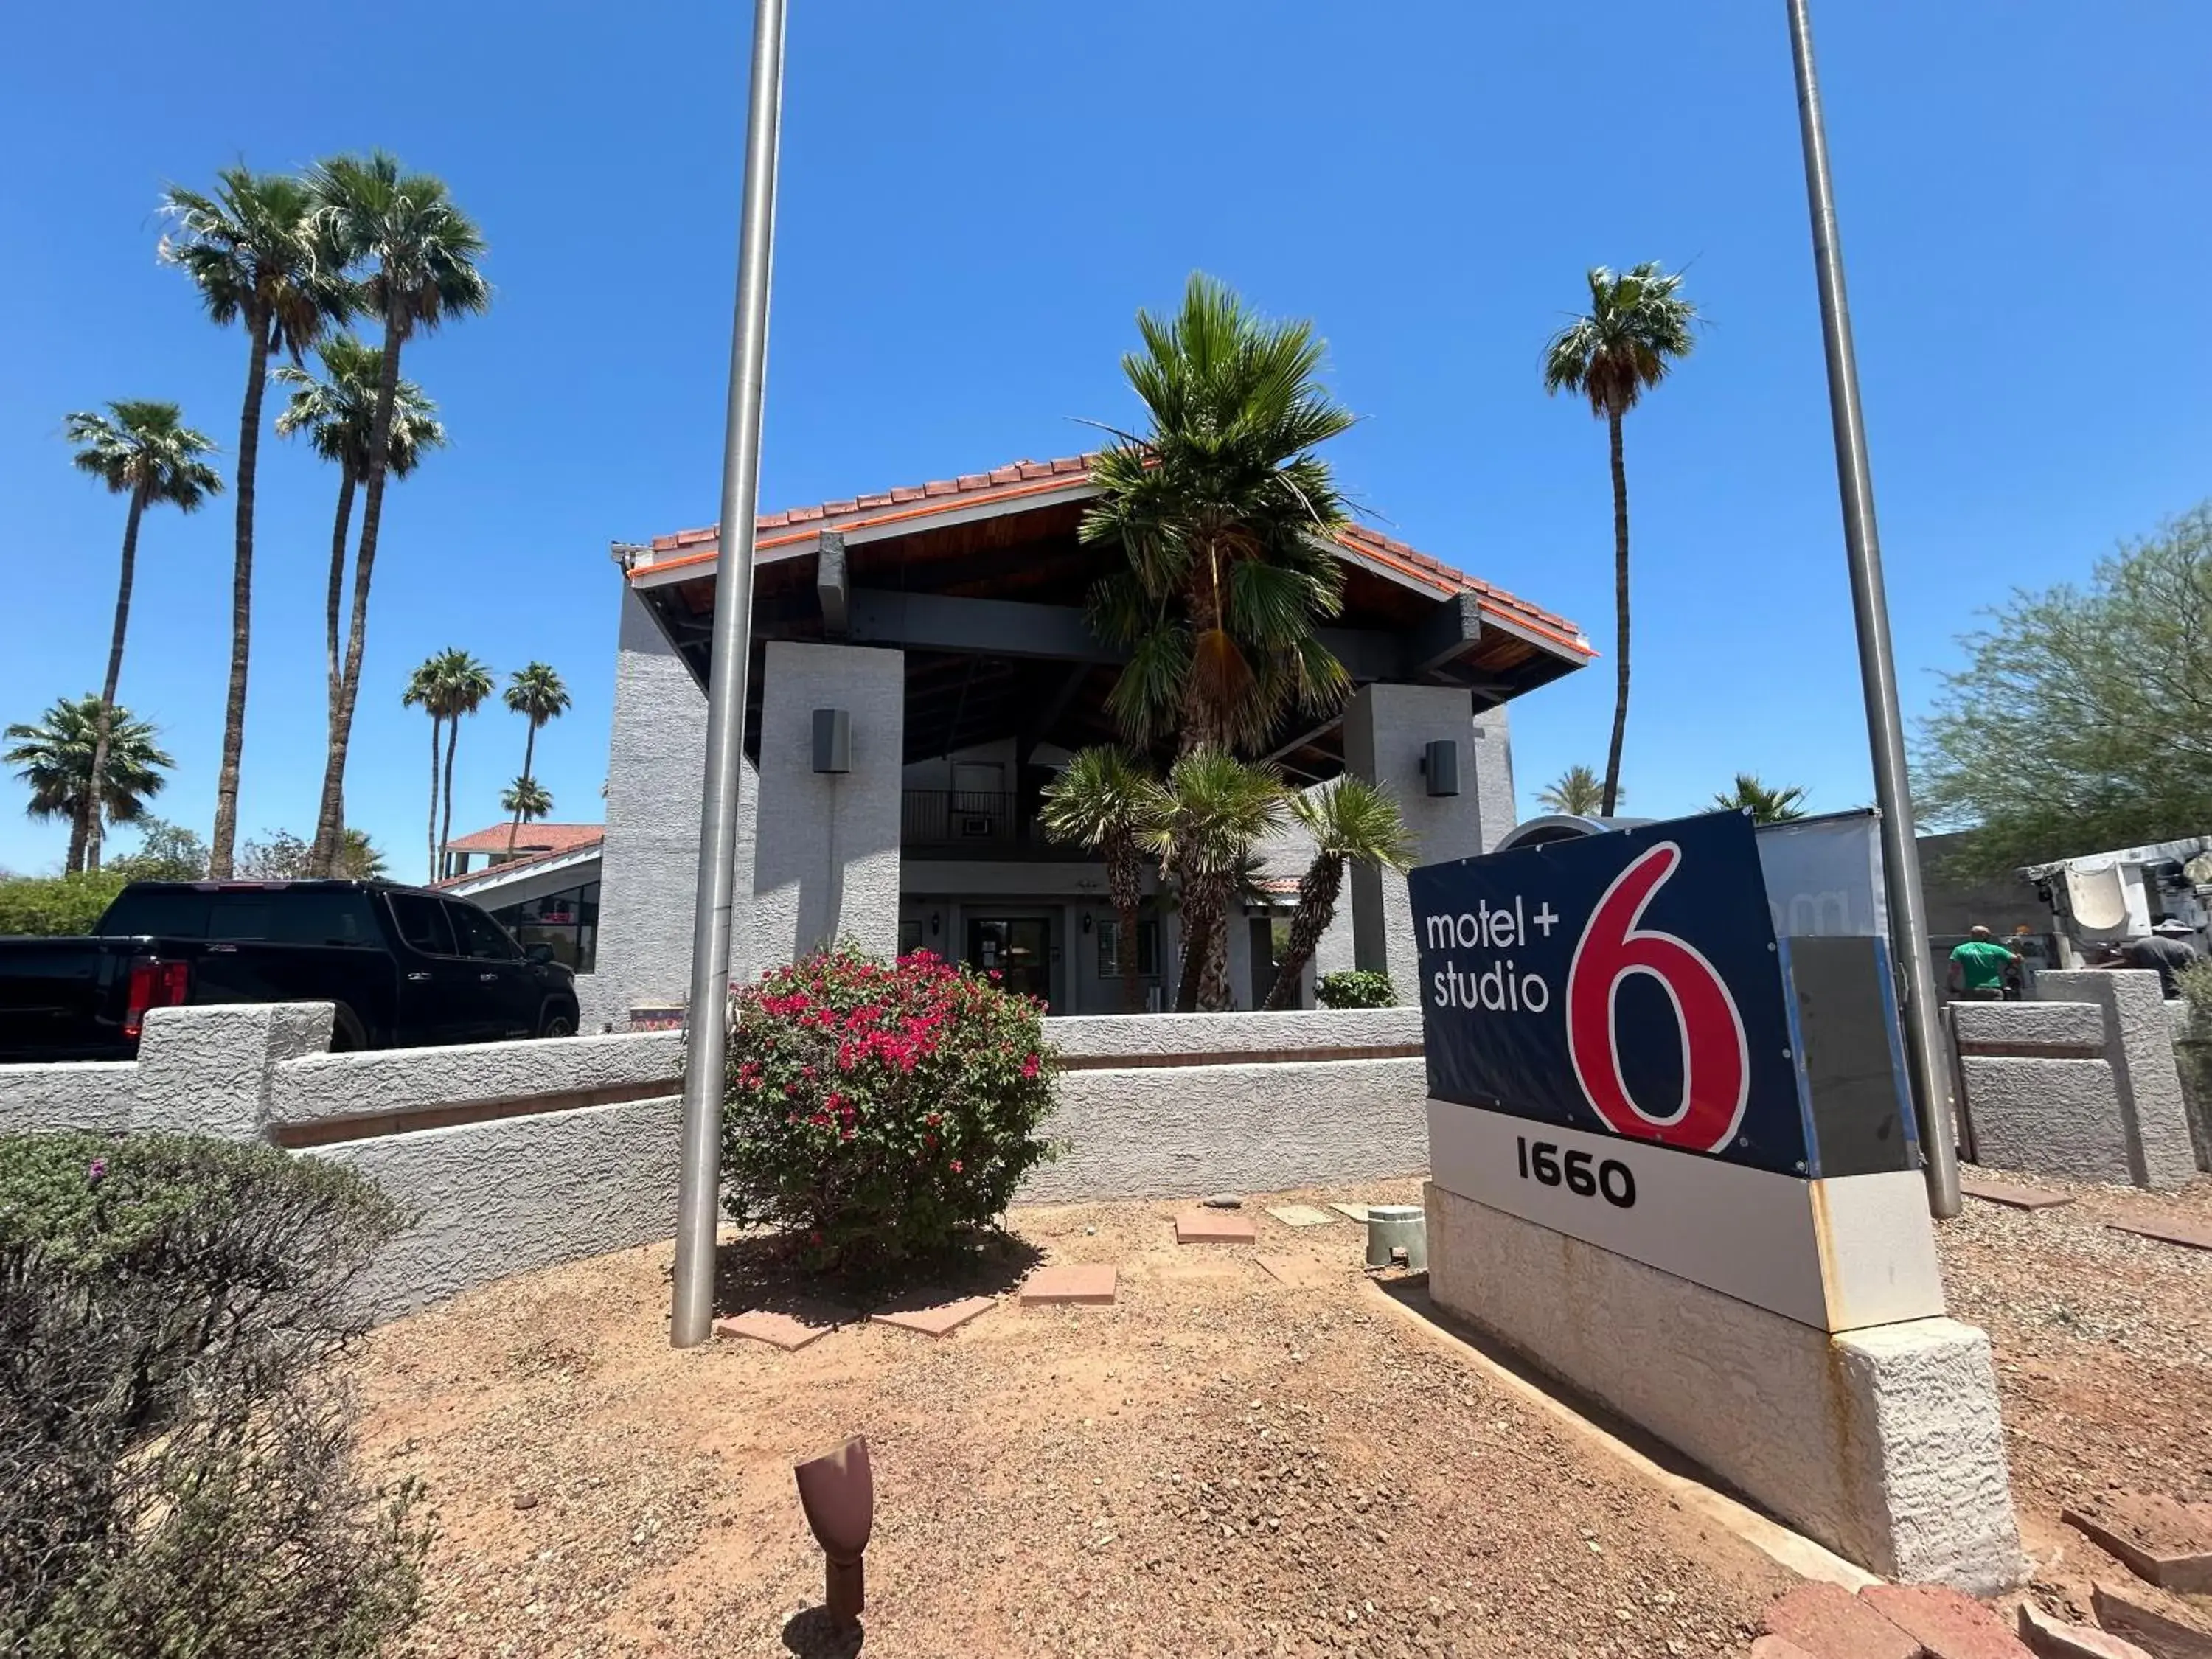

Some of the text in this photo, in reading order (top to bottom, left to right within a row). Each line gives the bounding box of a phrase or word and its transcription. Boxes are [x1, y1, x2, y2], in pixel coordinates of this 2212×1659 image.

[1434, 960, 1549, 1012] studio
[1566, 841, 1750, 1154] 6
[1517, 1135, 1637, 1209] 1660
